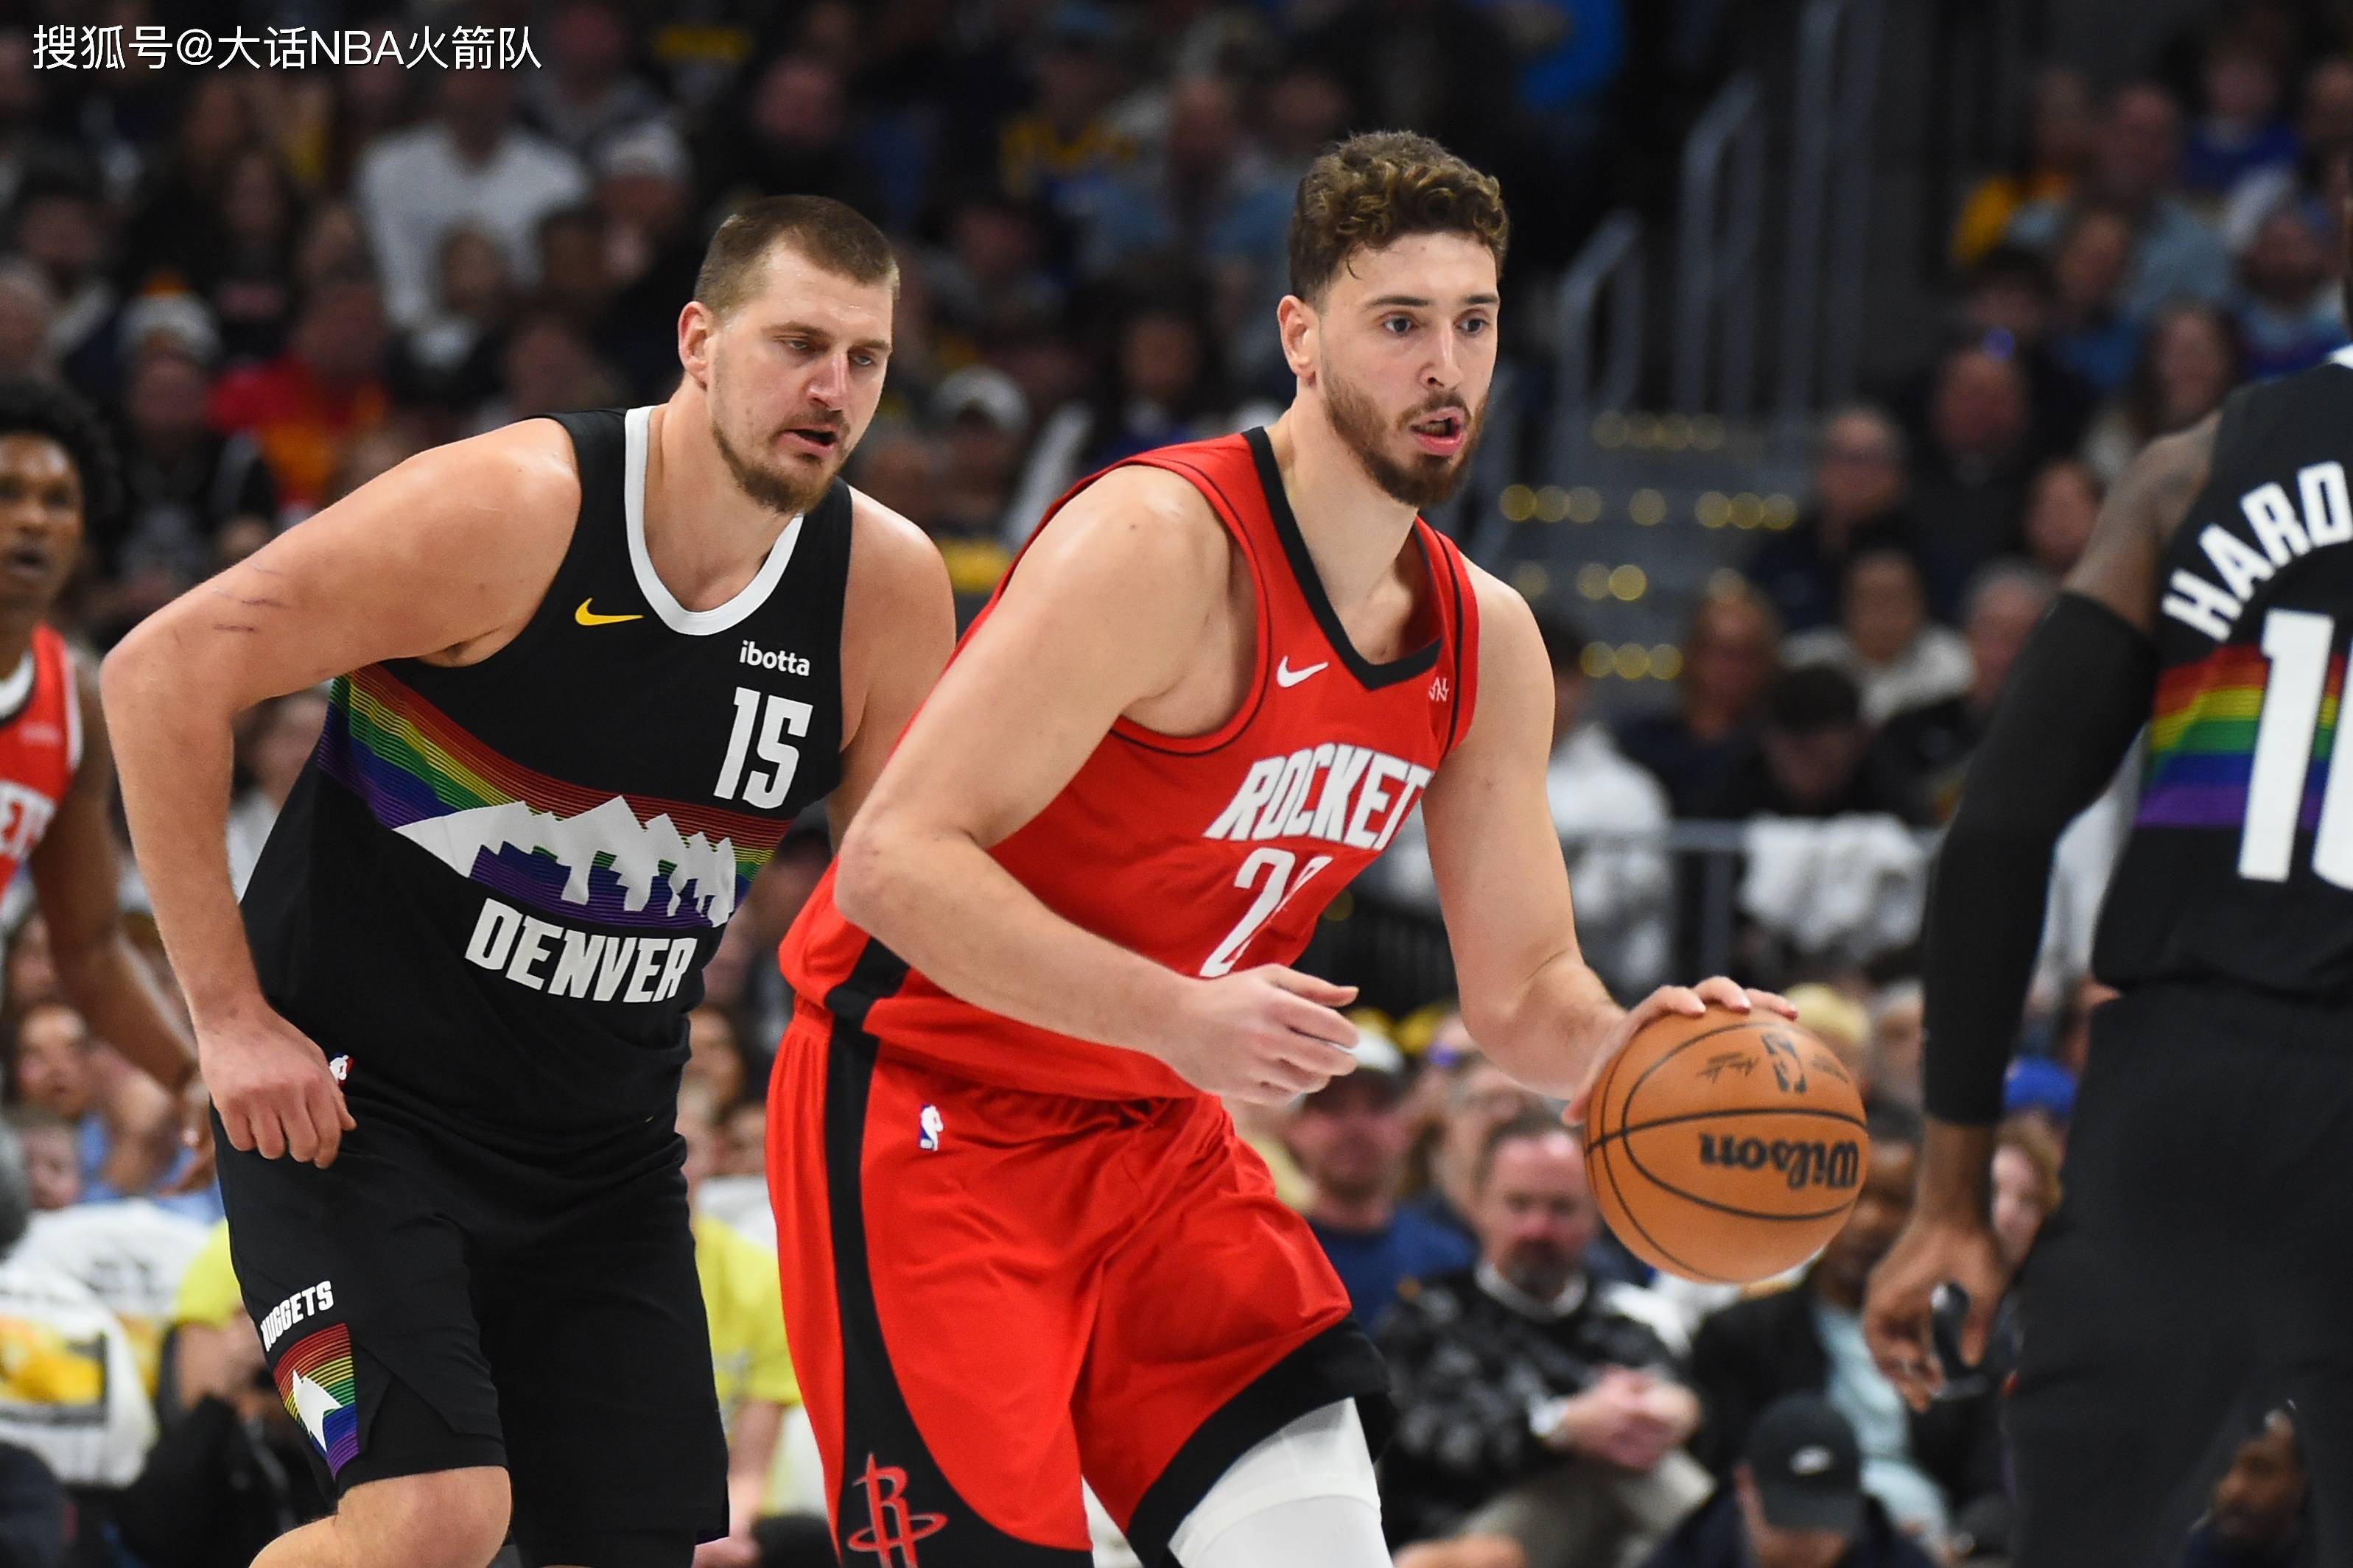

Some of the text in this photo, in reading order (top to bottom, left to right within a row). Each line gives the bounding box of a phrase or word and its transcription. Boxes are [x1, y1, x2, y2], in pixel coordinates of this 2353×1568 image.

[2161, 460, 2353, 641] HARD
[739, 639, 810, 677] ibotta
[713, 686, 813, 809] 15
[1202, 742, 1436, 851] ROCKET
[464, 897, 698, 1002] DENVER
[1699, 1131, 1859, 1191] Wilson
[260, 1280, 334, 1352] NUGGETS
